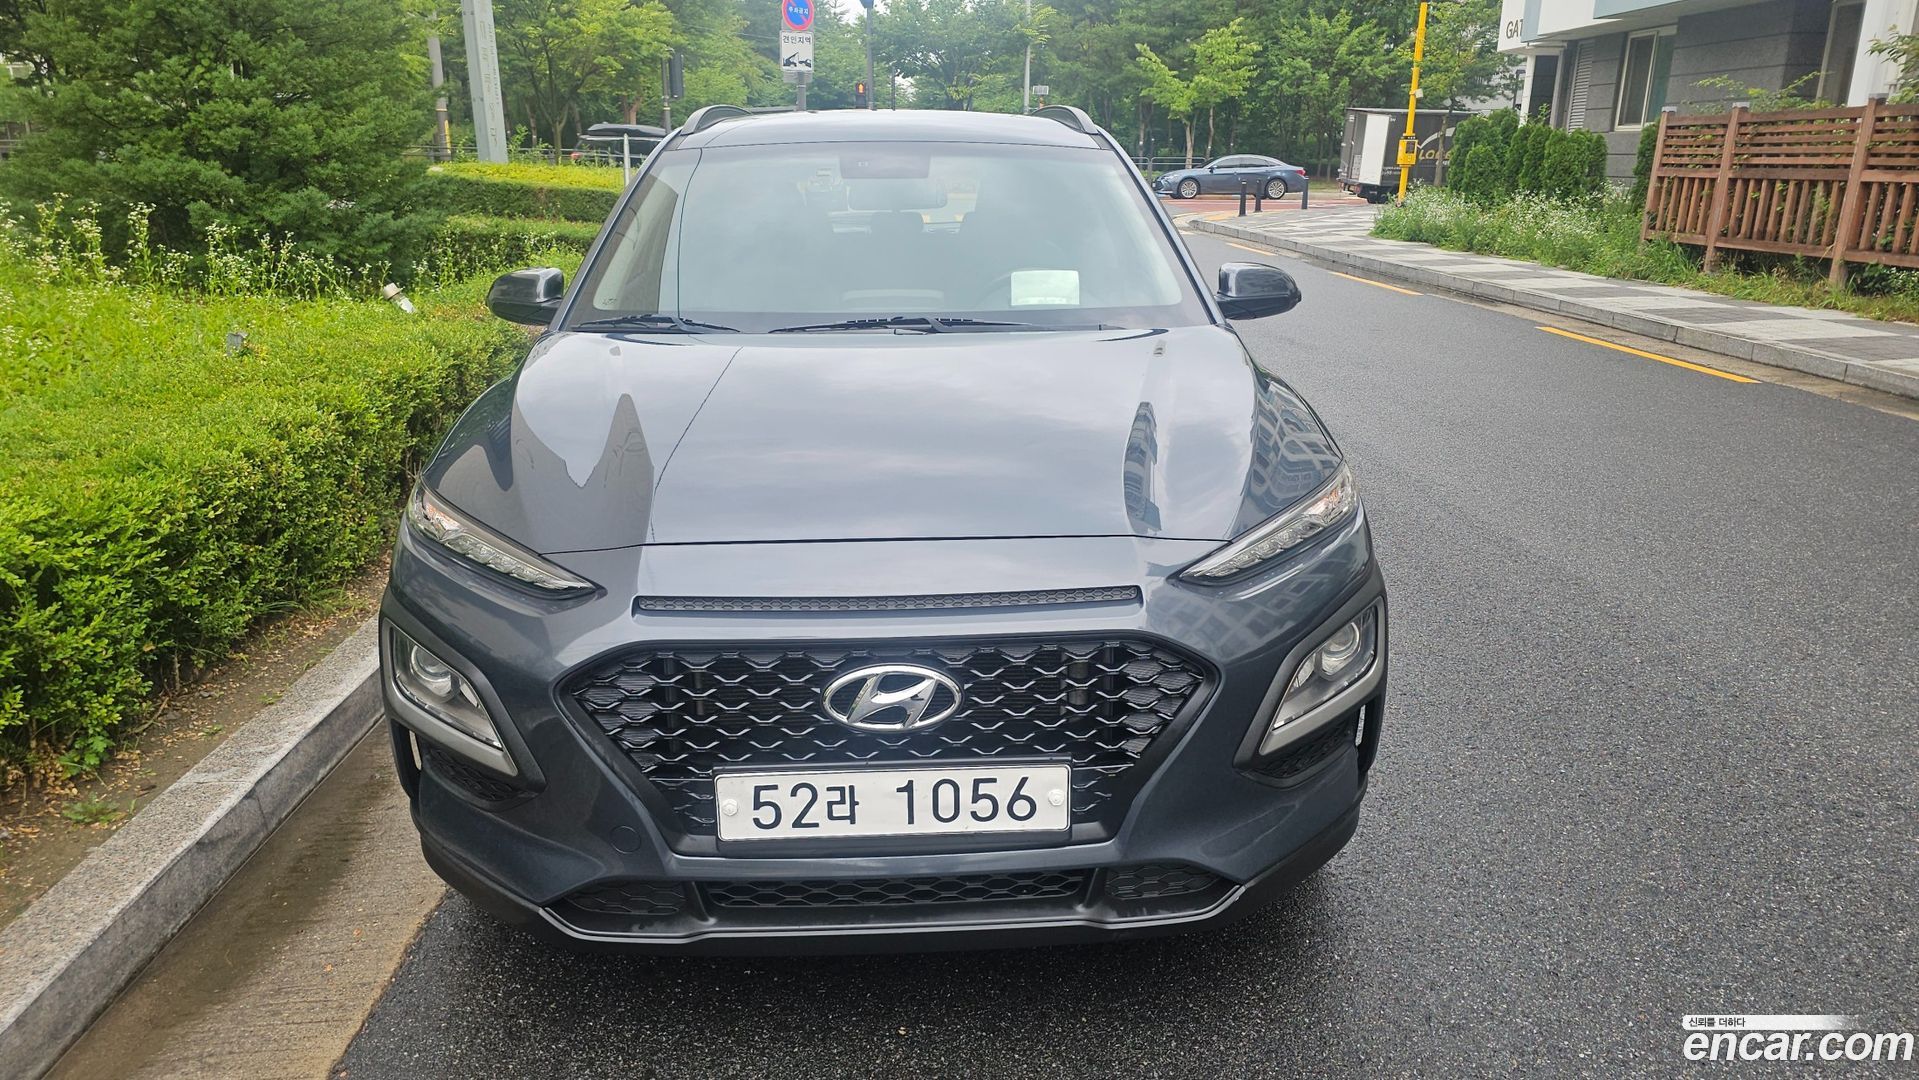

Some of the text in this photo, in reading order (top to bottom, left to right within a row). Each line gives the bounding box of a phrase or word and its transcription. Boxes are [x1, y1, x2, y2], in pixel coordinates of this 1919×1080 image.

[782, 35, 812, 45] 견인지역
[752, 776, 1037, 830] 52라 1056
